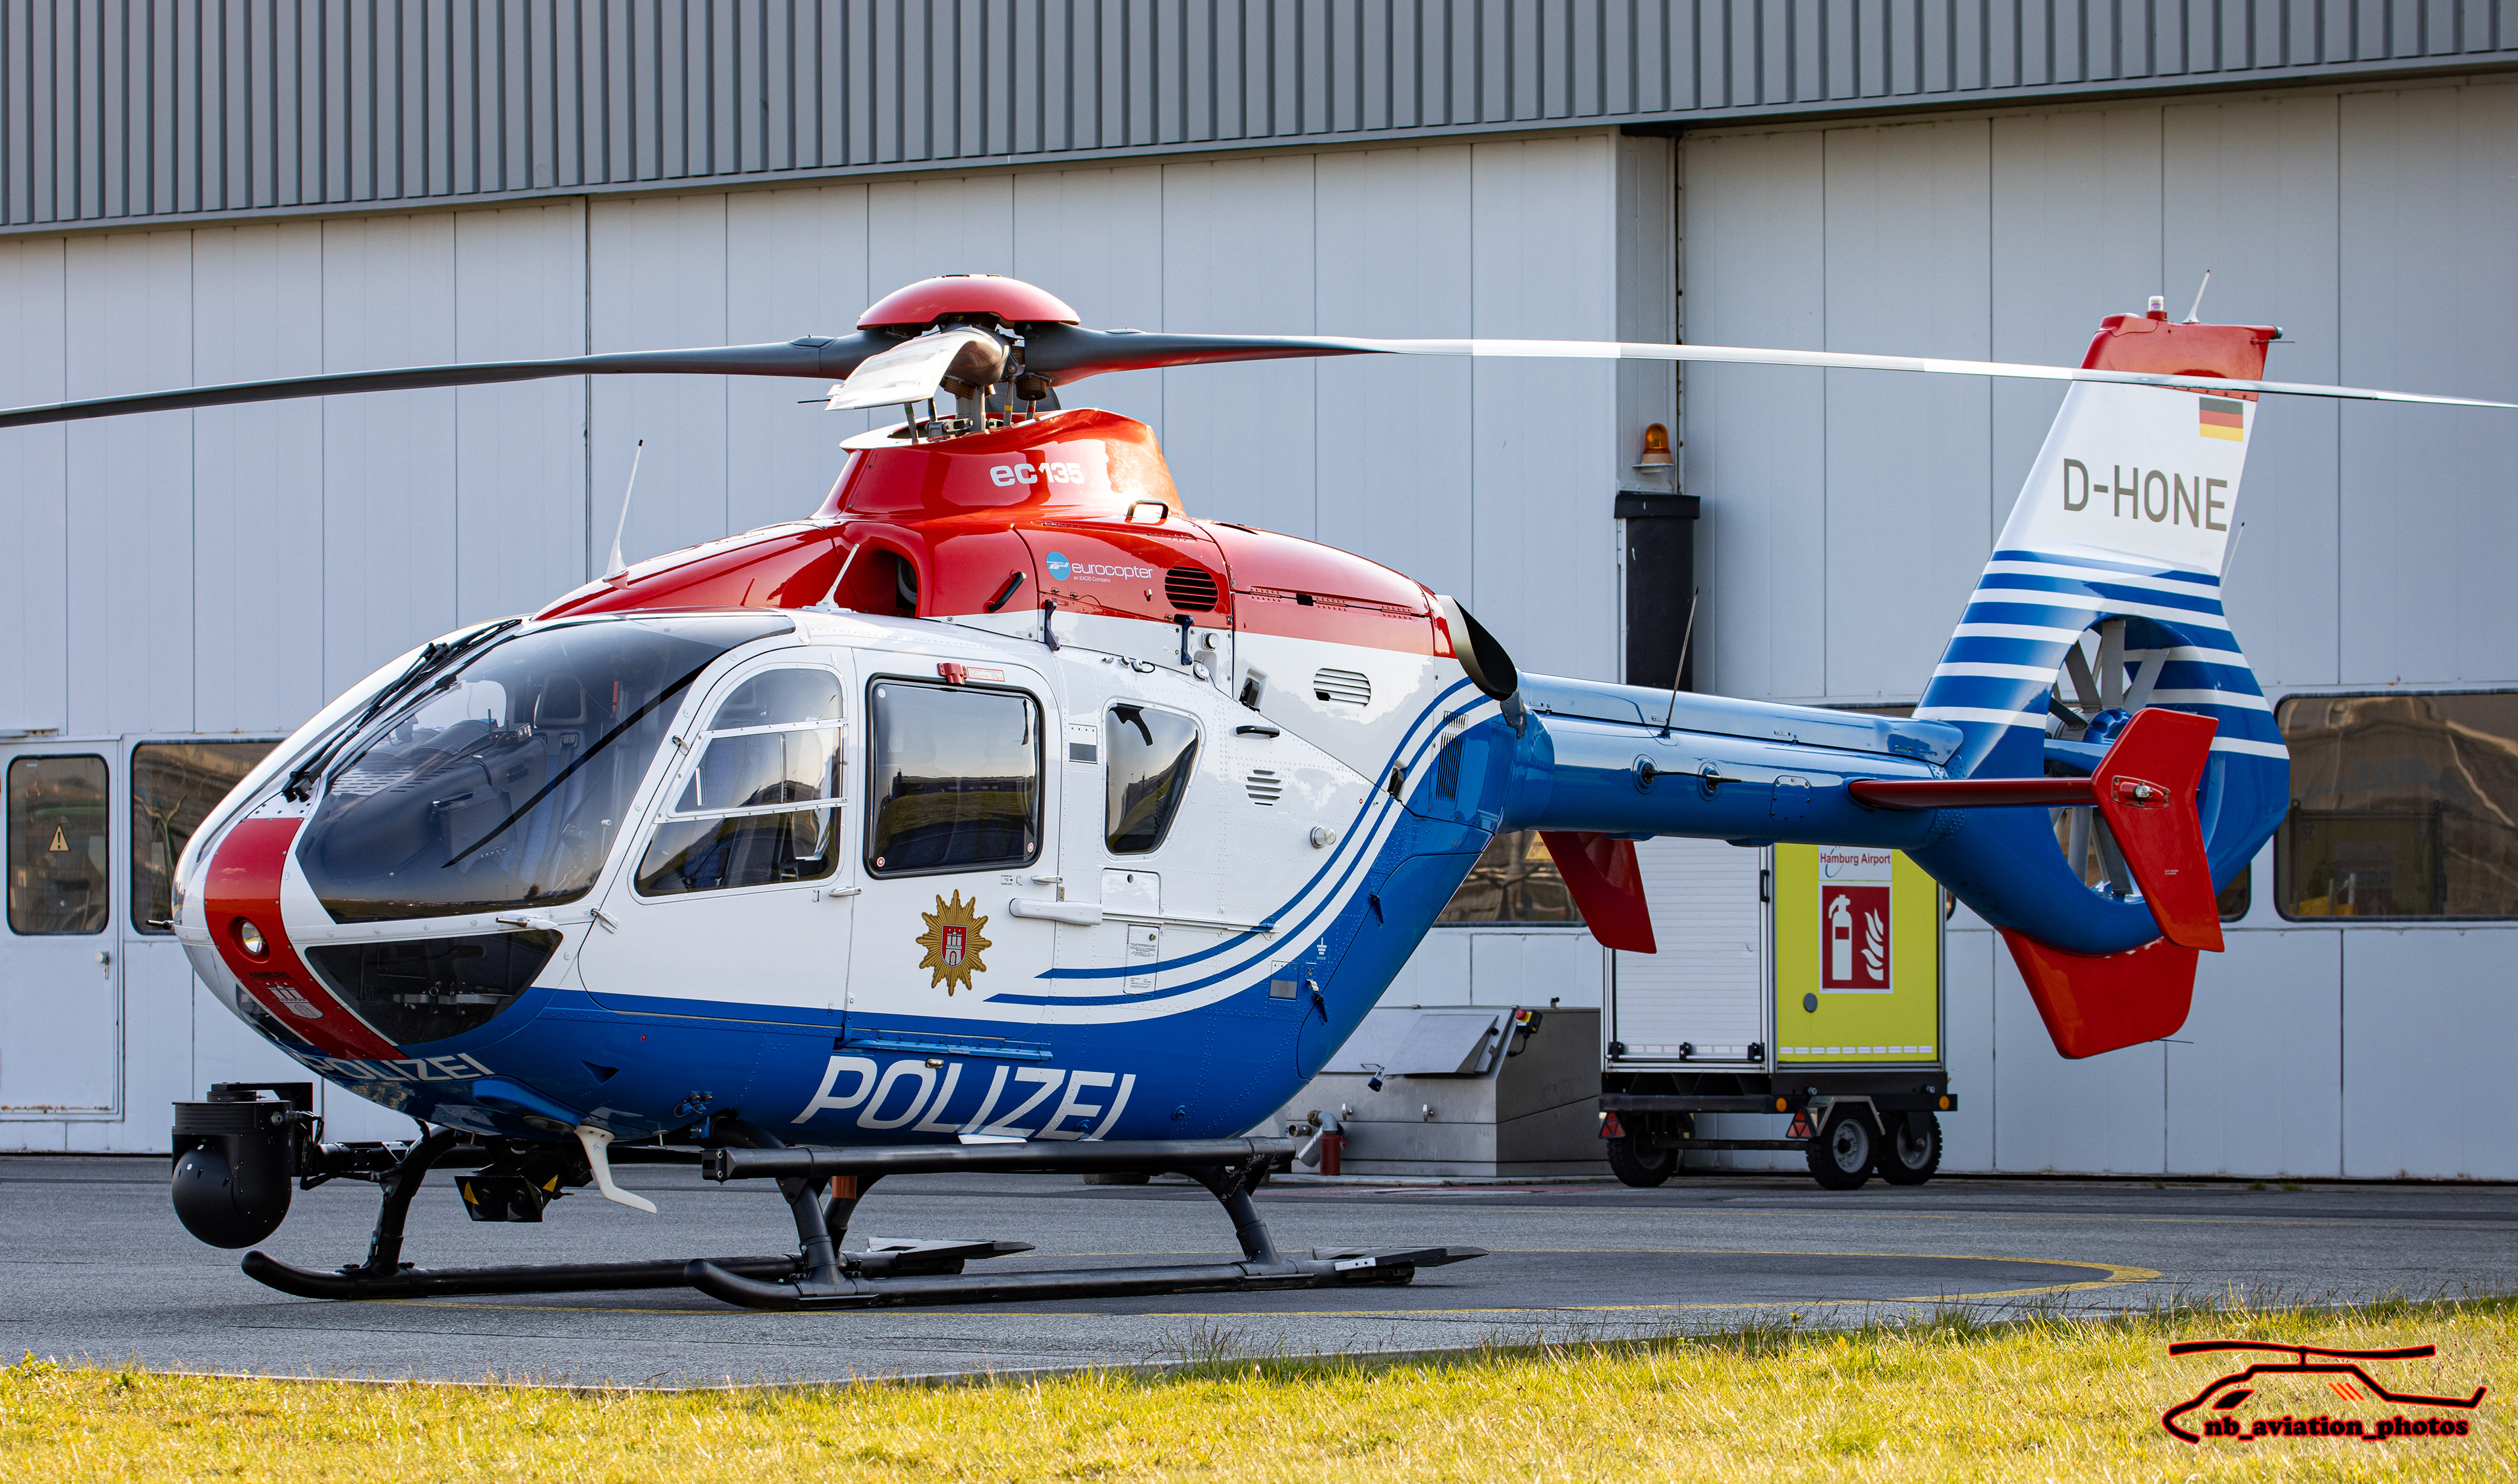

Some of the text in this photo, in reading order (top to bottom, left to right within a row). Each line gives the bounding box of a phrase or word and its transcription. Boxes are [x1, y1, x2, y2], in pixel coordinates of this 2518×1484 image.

[2064, 458, 2228, 531] D-HONE
[1071, 563, 1153, 580] eurocopter
[1820, 853, 1891, 866] Hamburg Airport
[294, 1052, 496, 1081] POLIZEI
[791, 1056, 1136, 1140] POLIZEI
